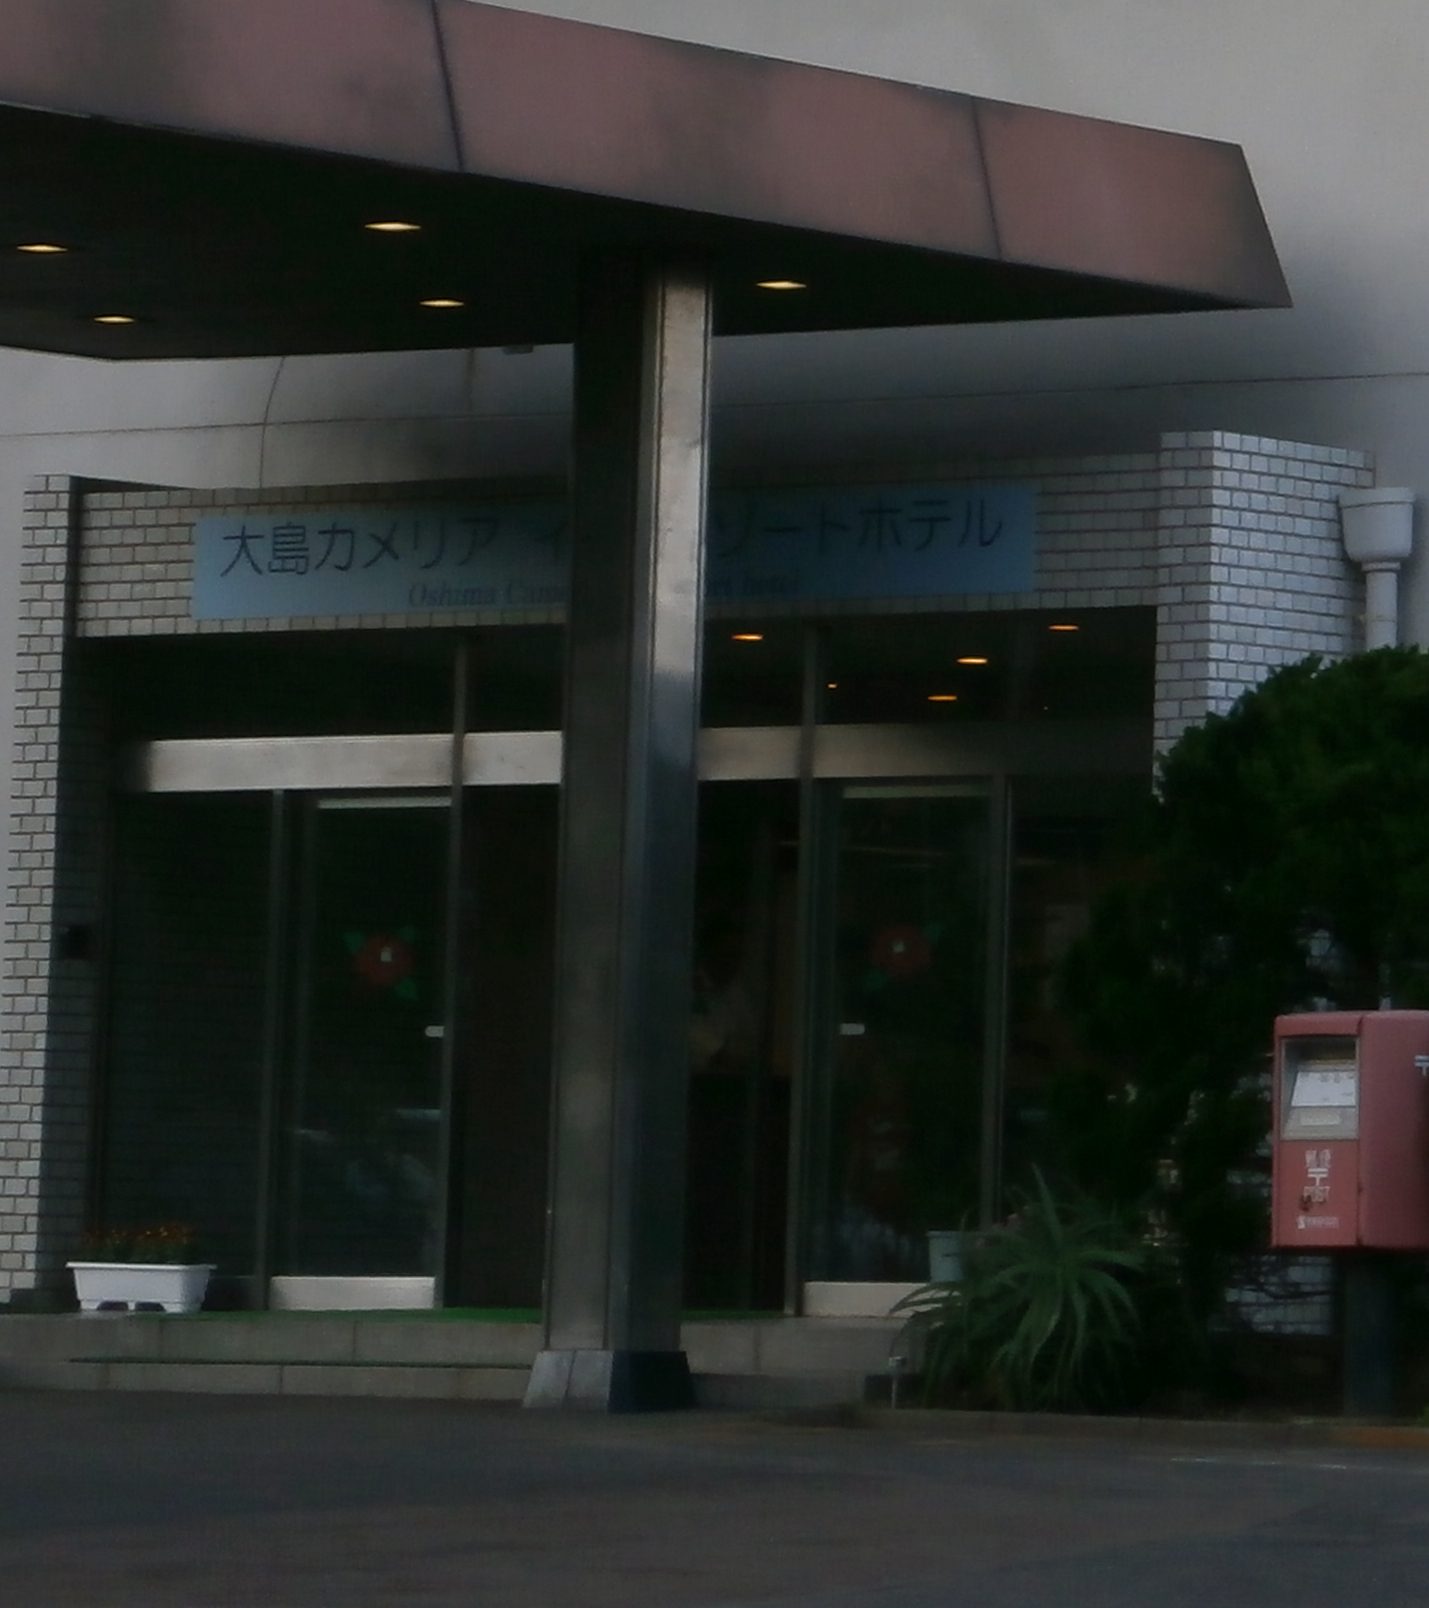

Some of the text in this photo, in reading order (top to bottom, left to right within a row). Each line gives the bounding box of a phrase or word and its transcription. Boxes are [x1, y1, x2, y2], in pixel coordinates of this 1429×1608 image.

[220, 514, 500, 577] 大島カメリア
